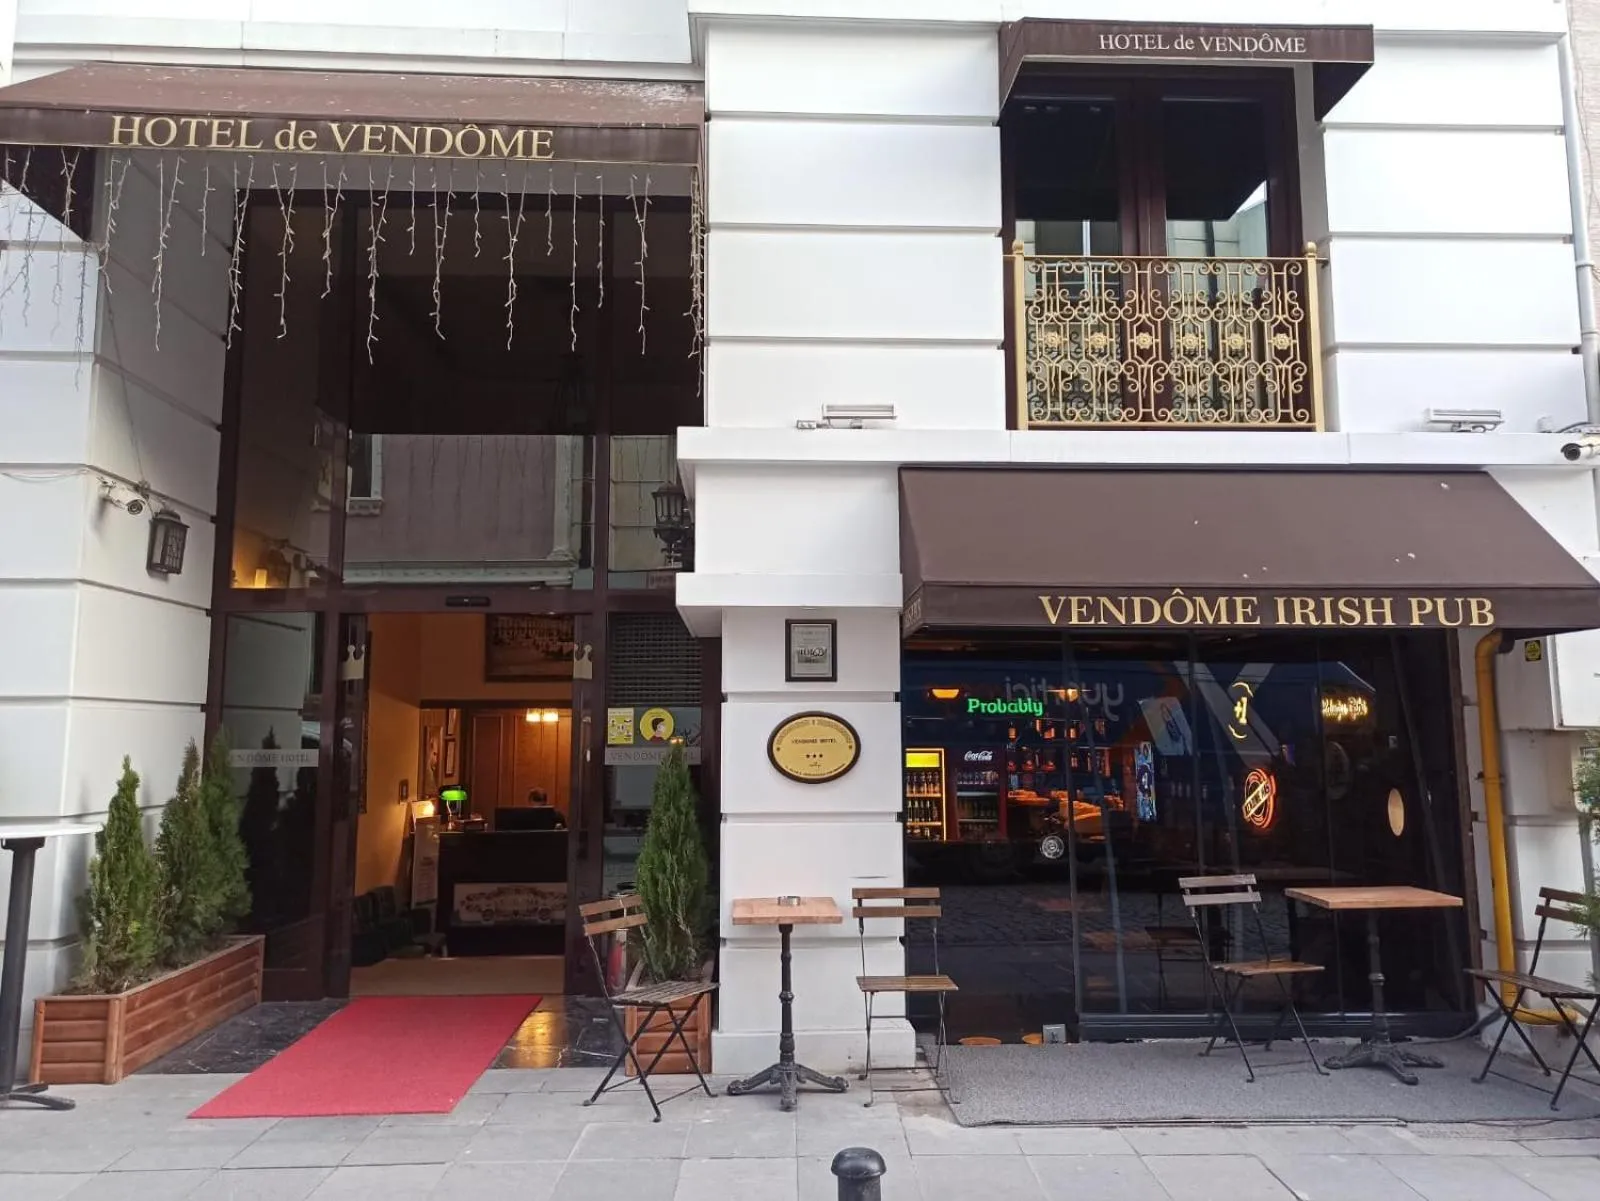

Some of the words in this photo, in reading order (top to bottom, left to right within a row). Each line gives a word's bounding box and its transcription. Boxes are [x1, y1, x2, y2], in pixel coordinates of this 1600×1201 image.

[1100, 34, 1169, 50] HOTEL
[1174, 35, 1195, 50] de
[1200, 33, 1306, 53] VENDÔME
[109, 115, 263, 149] HOTEL
[274, 120, 317, 150] de
[328, 123, 555, 159] VENDÔME
[1038, 588, 1261, 625] VENDÔME
[1273, 597, 1396, 626] IRISH
[1407, 597, 1495, 626] PUB
[967, 697, 1043, 716] Probably
